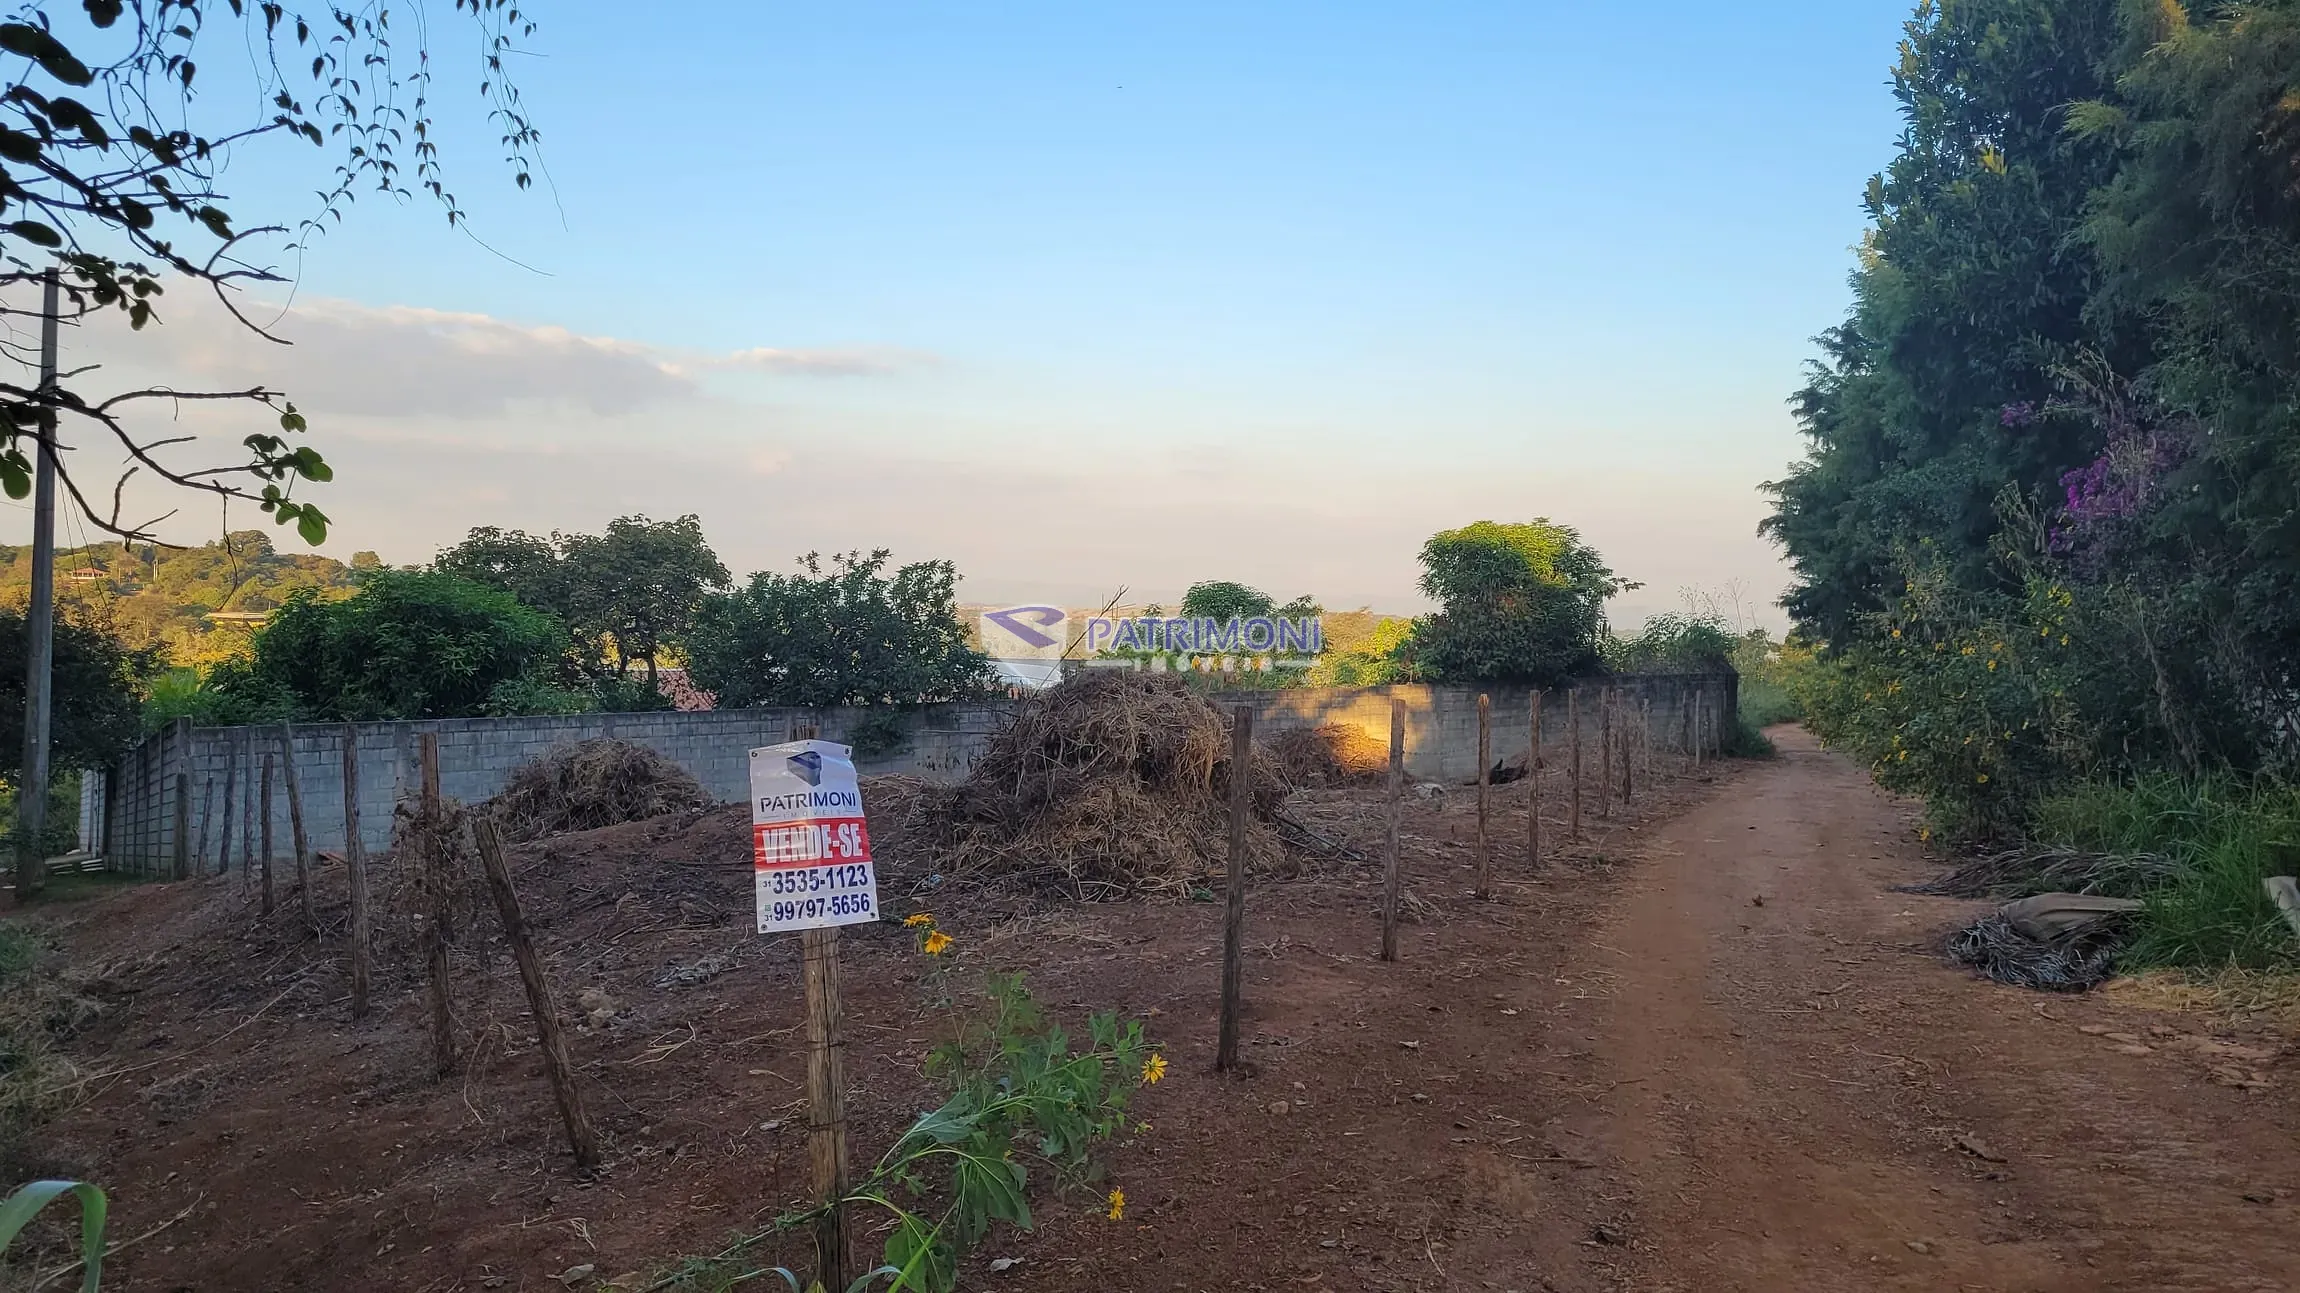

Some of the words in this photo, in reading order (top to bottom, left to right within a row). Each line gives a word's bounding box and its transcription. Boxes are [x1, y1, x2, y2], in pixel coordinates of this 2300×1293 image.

[760, 791, 856, 813] PATRIMONI
[762, 823, 863, 864] VENDE-SE
[762, 880, 771, 888] 31
[772, 864, 868, 894] 3535-1123
[773, 893, 870, 921] 99797-5656
